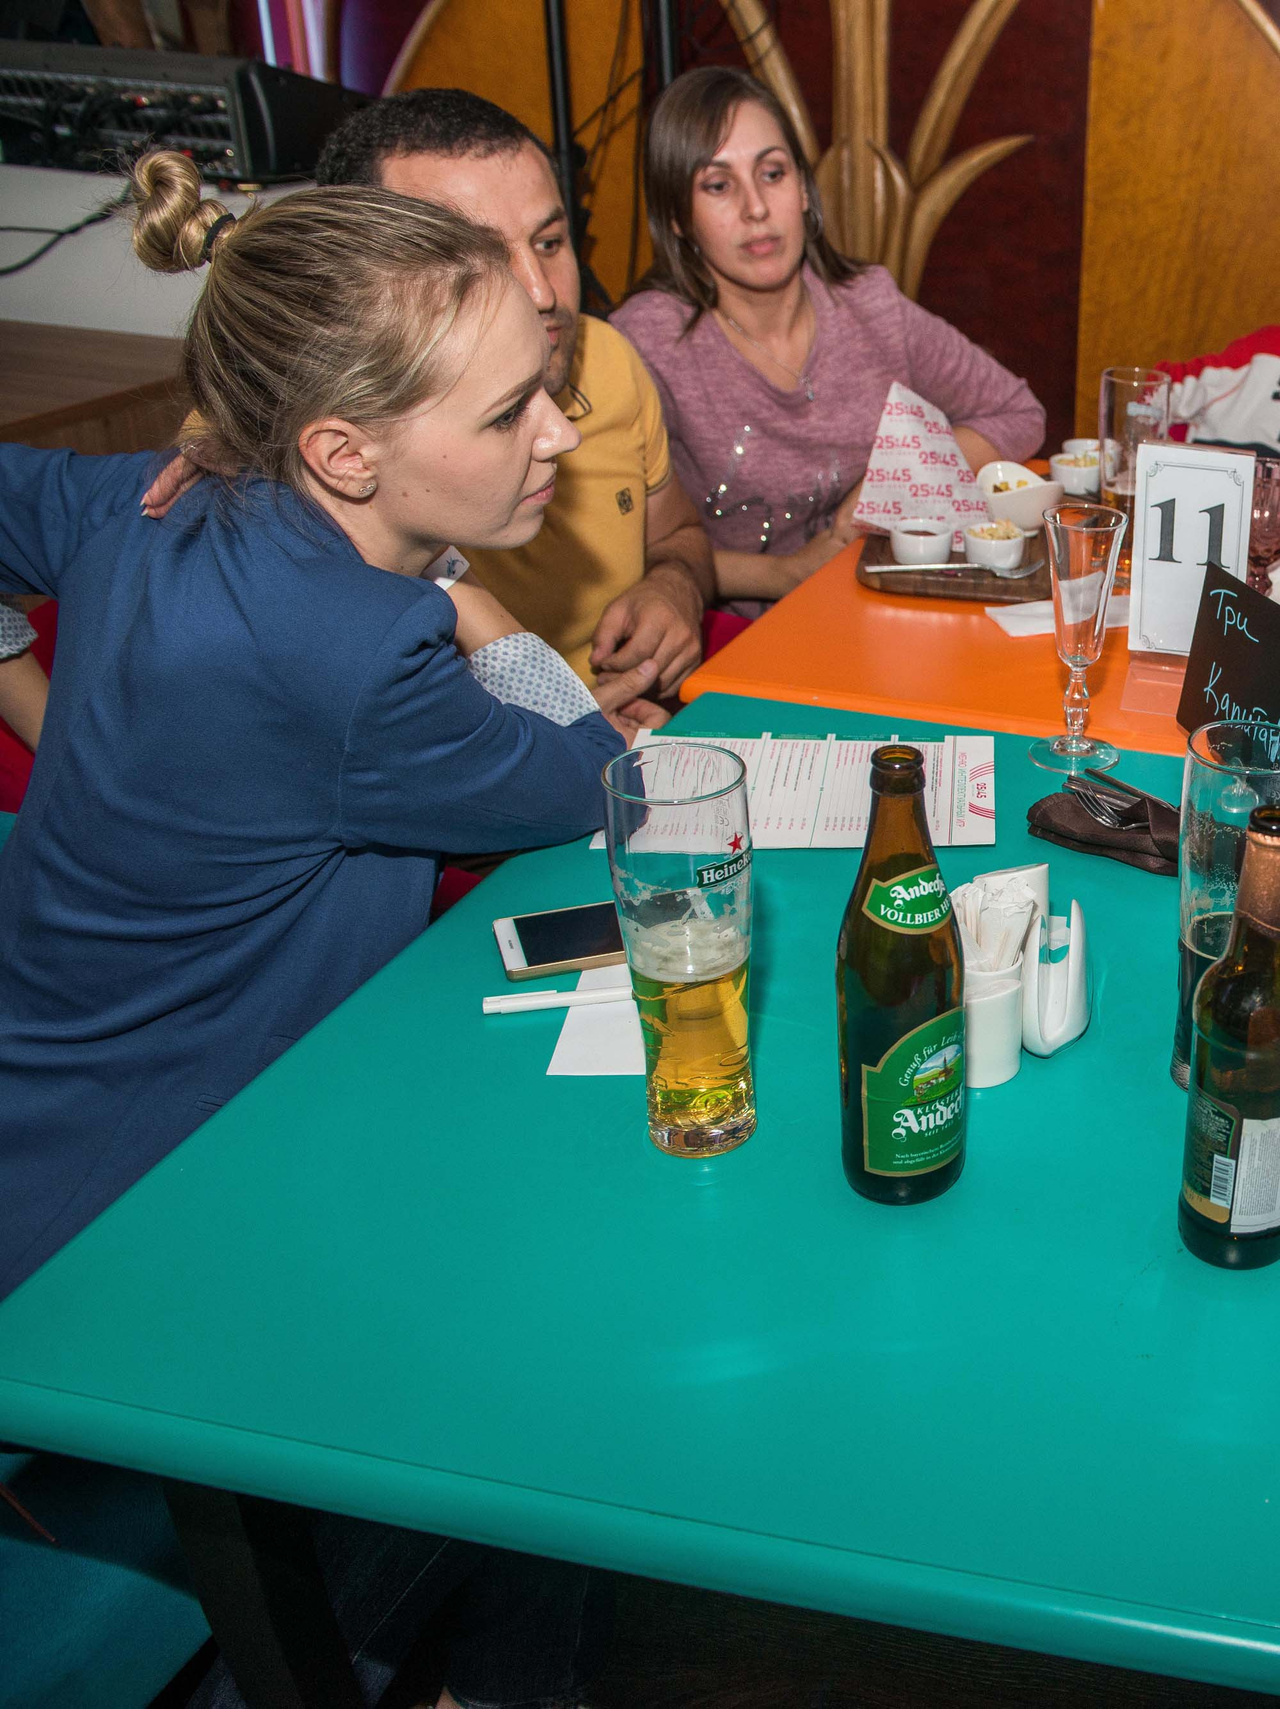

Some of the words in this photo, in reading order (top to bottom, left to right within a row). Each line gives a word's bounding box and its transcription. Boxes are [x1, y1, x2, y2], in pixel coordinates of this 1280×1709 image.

[886, 402, 926, 419] 25:45
[924, 420, 952, 436] 25:4
[875, 435, 922, 449] 25:45
[918, 451, 959, 467] 25:45
[866, 468, 912, 483] 25:45
[909, 484, 954, 498] 25:45
[857, 501, 902, 515] 25:45
[1148, 497, 1231, 569] 11
[1210, 588, 1260, 643] Три
[702, 852, 752, 885] Heinek
[880, 903, 942, 925] VOLLBIER
[898, 1053, 921, 1087] Genuß
[922, 1043, 938, 1060] für
